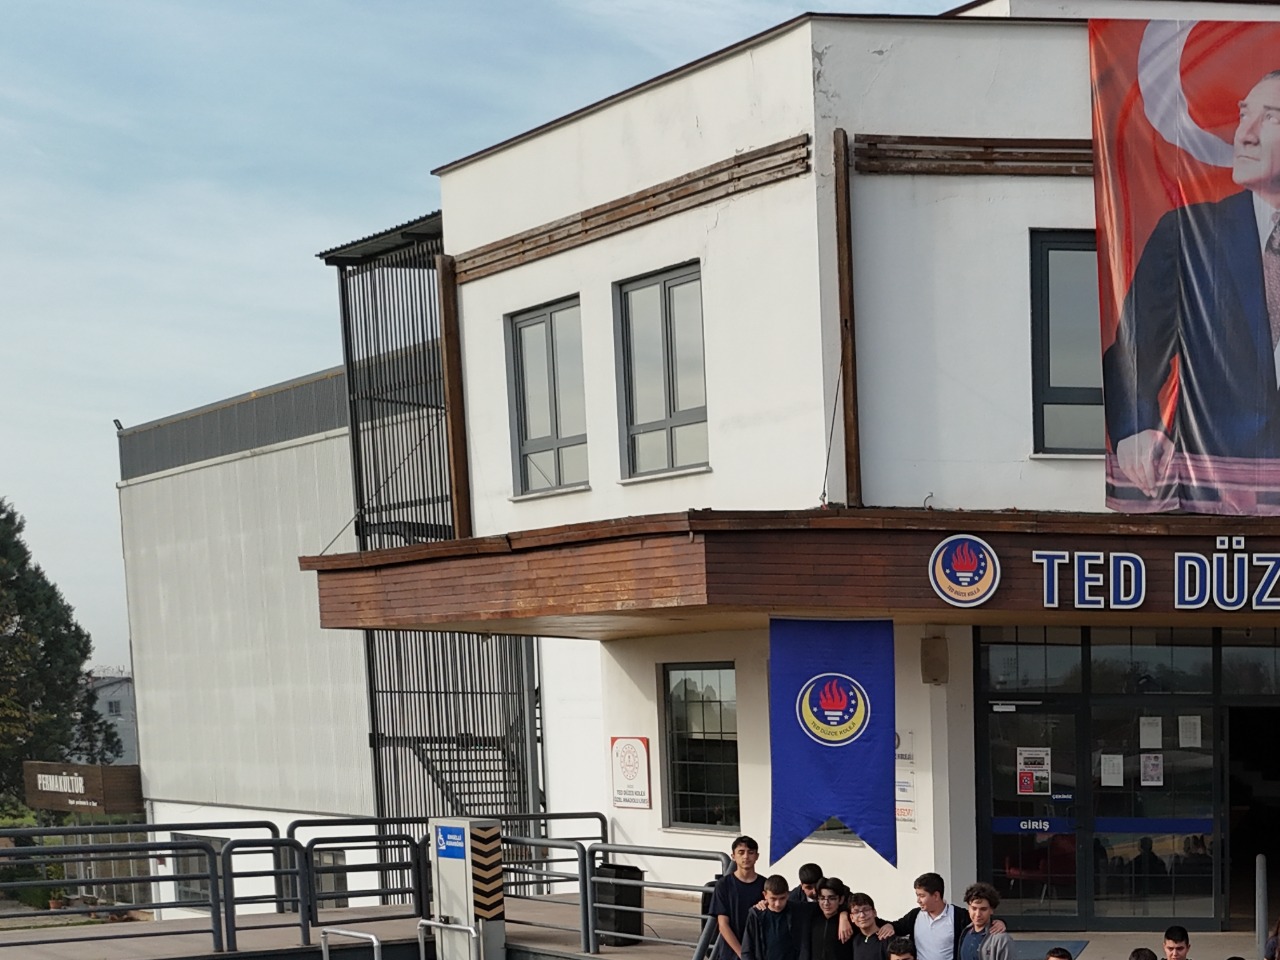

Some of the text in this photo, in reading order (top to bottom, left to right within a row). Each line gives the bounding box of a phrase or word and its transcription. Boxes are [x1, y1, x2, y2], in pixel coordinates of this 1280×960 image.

[1032, 550, 1146, 608] TED
[37, 771, 85, 794] PERMAKÜLTÜR
[1020, 819, 1050, 831] GİRİŞ
